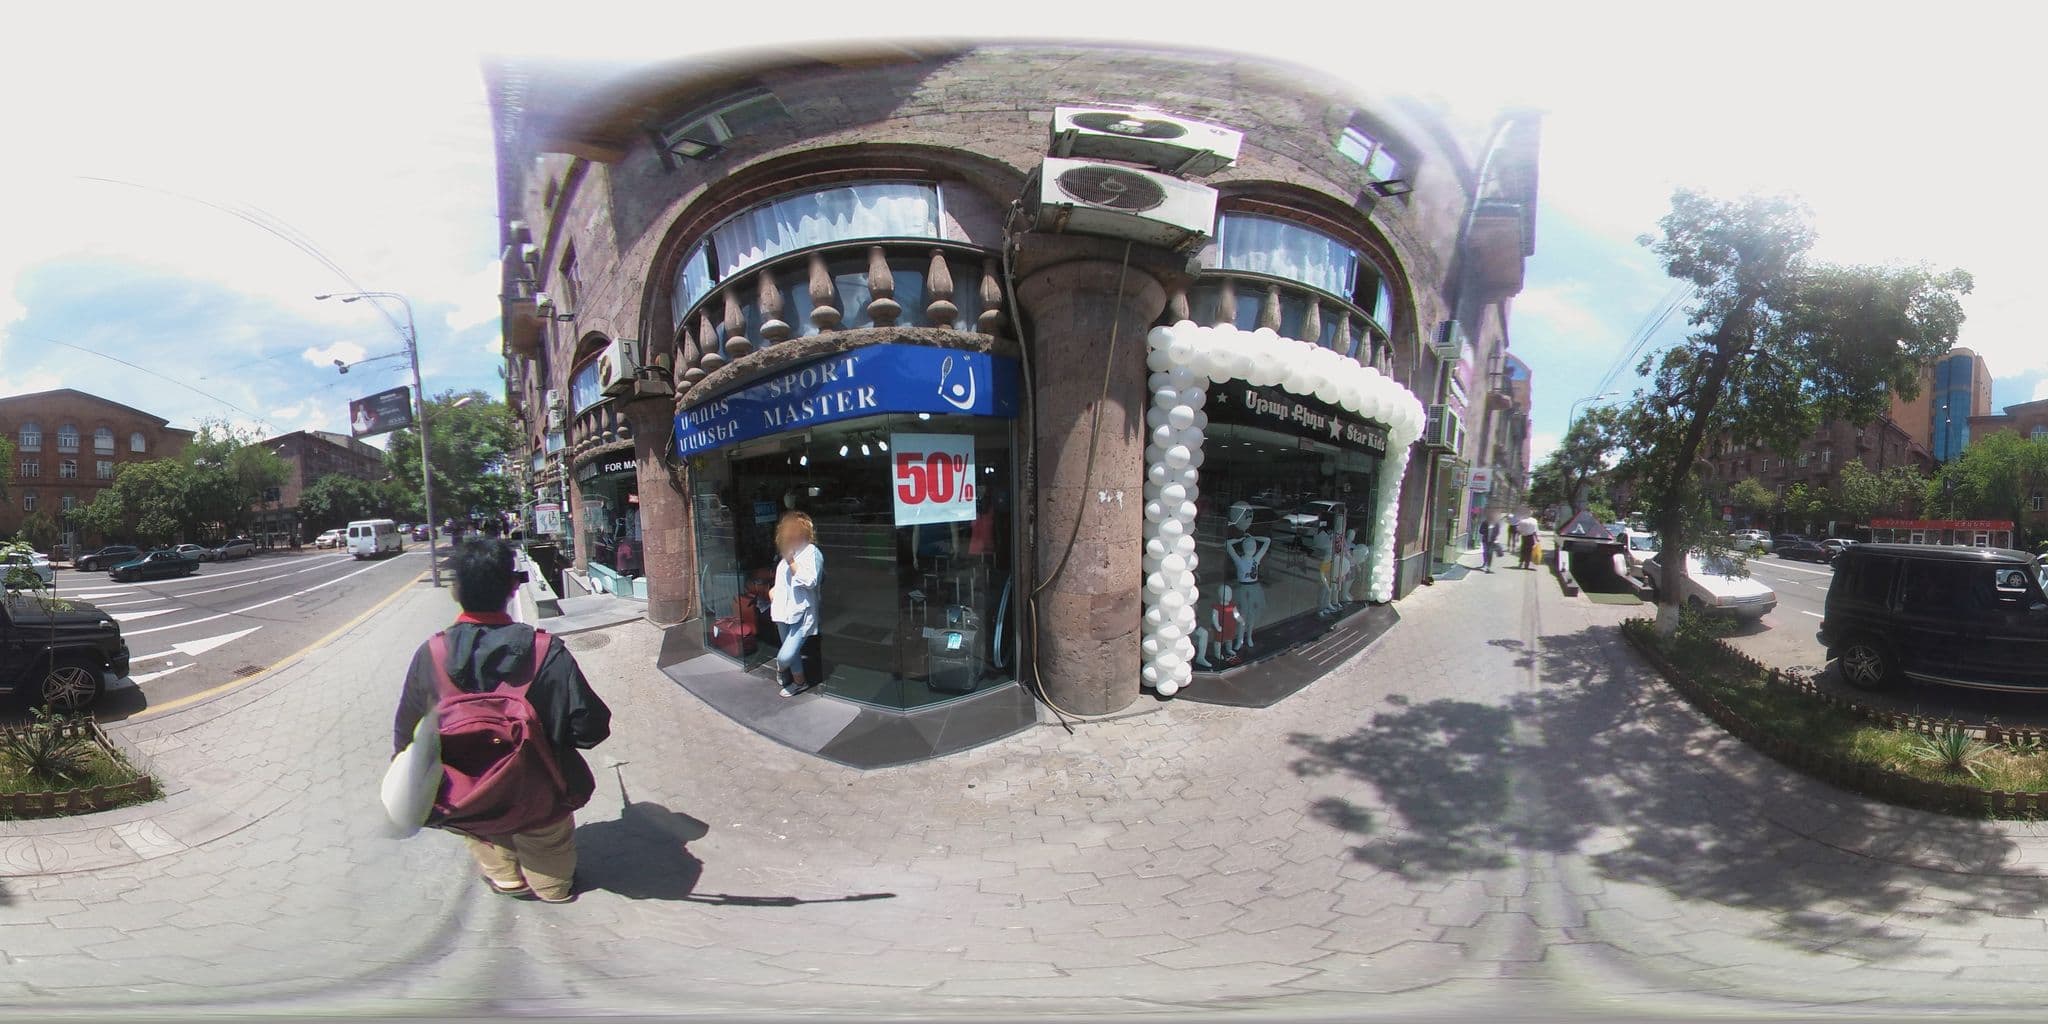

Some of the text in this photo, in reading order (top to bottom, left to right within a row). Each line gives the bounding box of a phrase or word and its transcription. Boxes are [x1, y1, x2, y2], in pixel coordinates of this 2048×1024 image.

[769, 356, 859, 398] SPORT
[681, 398, 729, 431] ՍՊՈՐՏ
[763, 384, 877, 428] MASTER
[679, 419, 739, 452] ՄԱՍՏԵՐ
[1347, 424, 1386, 451] Star Kids
[604, 459, 637, 472] FOR MA
[896, 451, 975, 505] 50%
